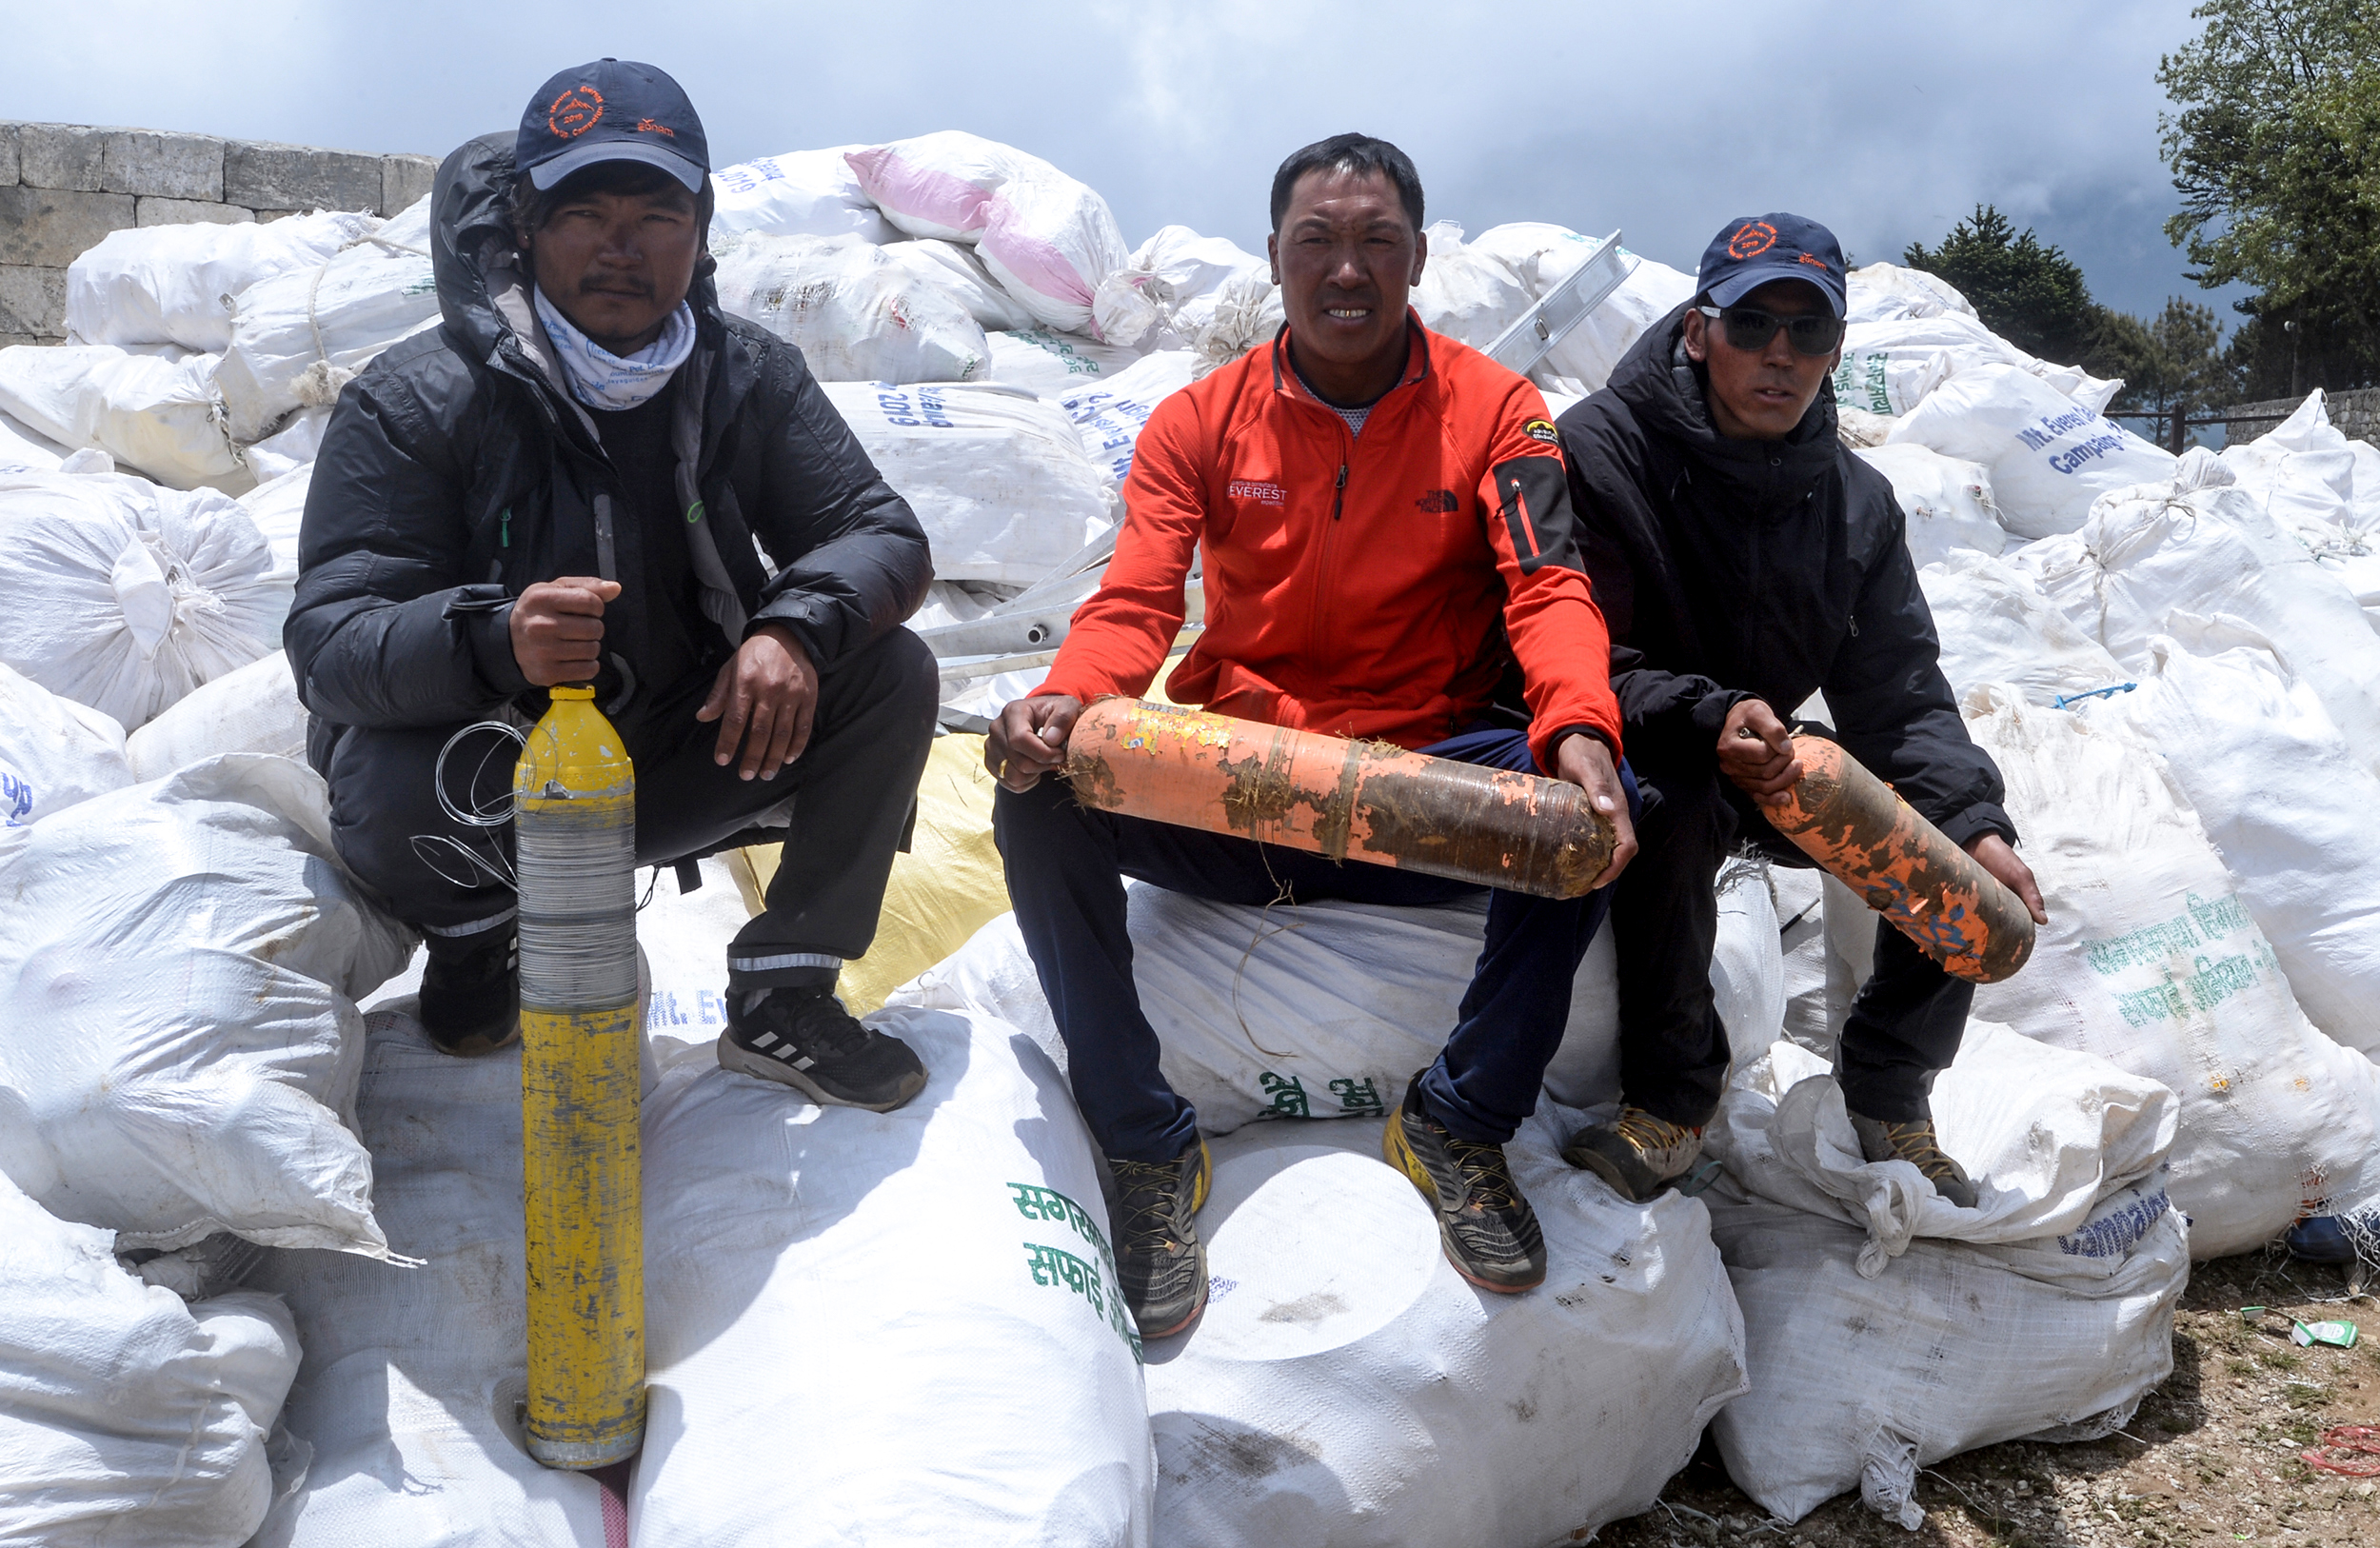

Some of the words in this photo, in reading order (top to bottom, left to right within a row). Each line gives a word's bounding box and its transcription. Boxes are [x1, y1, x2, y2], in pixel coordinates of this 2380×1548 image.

[877, 392, 922, 427] 2019
[2014, 427, 2055, 452] Mt.
[1228, 485, 1288, 501] EVEREST
[1022, 1241, 1104, 1322] सफाई
